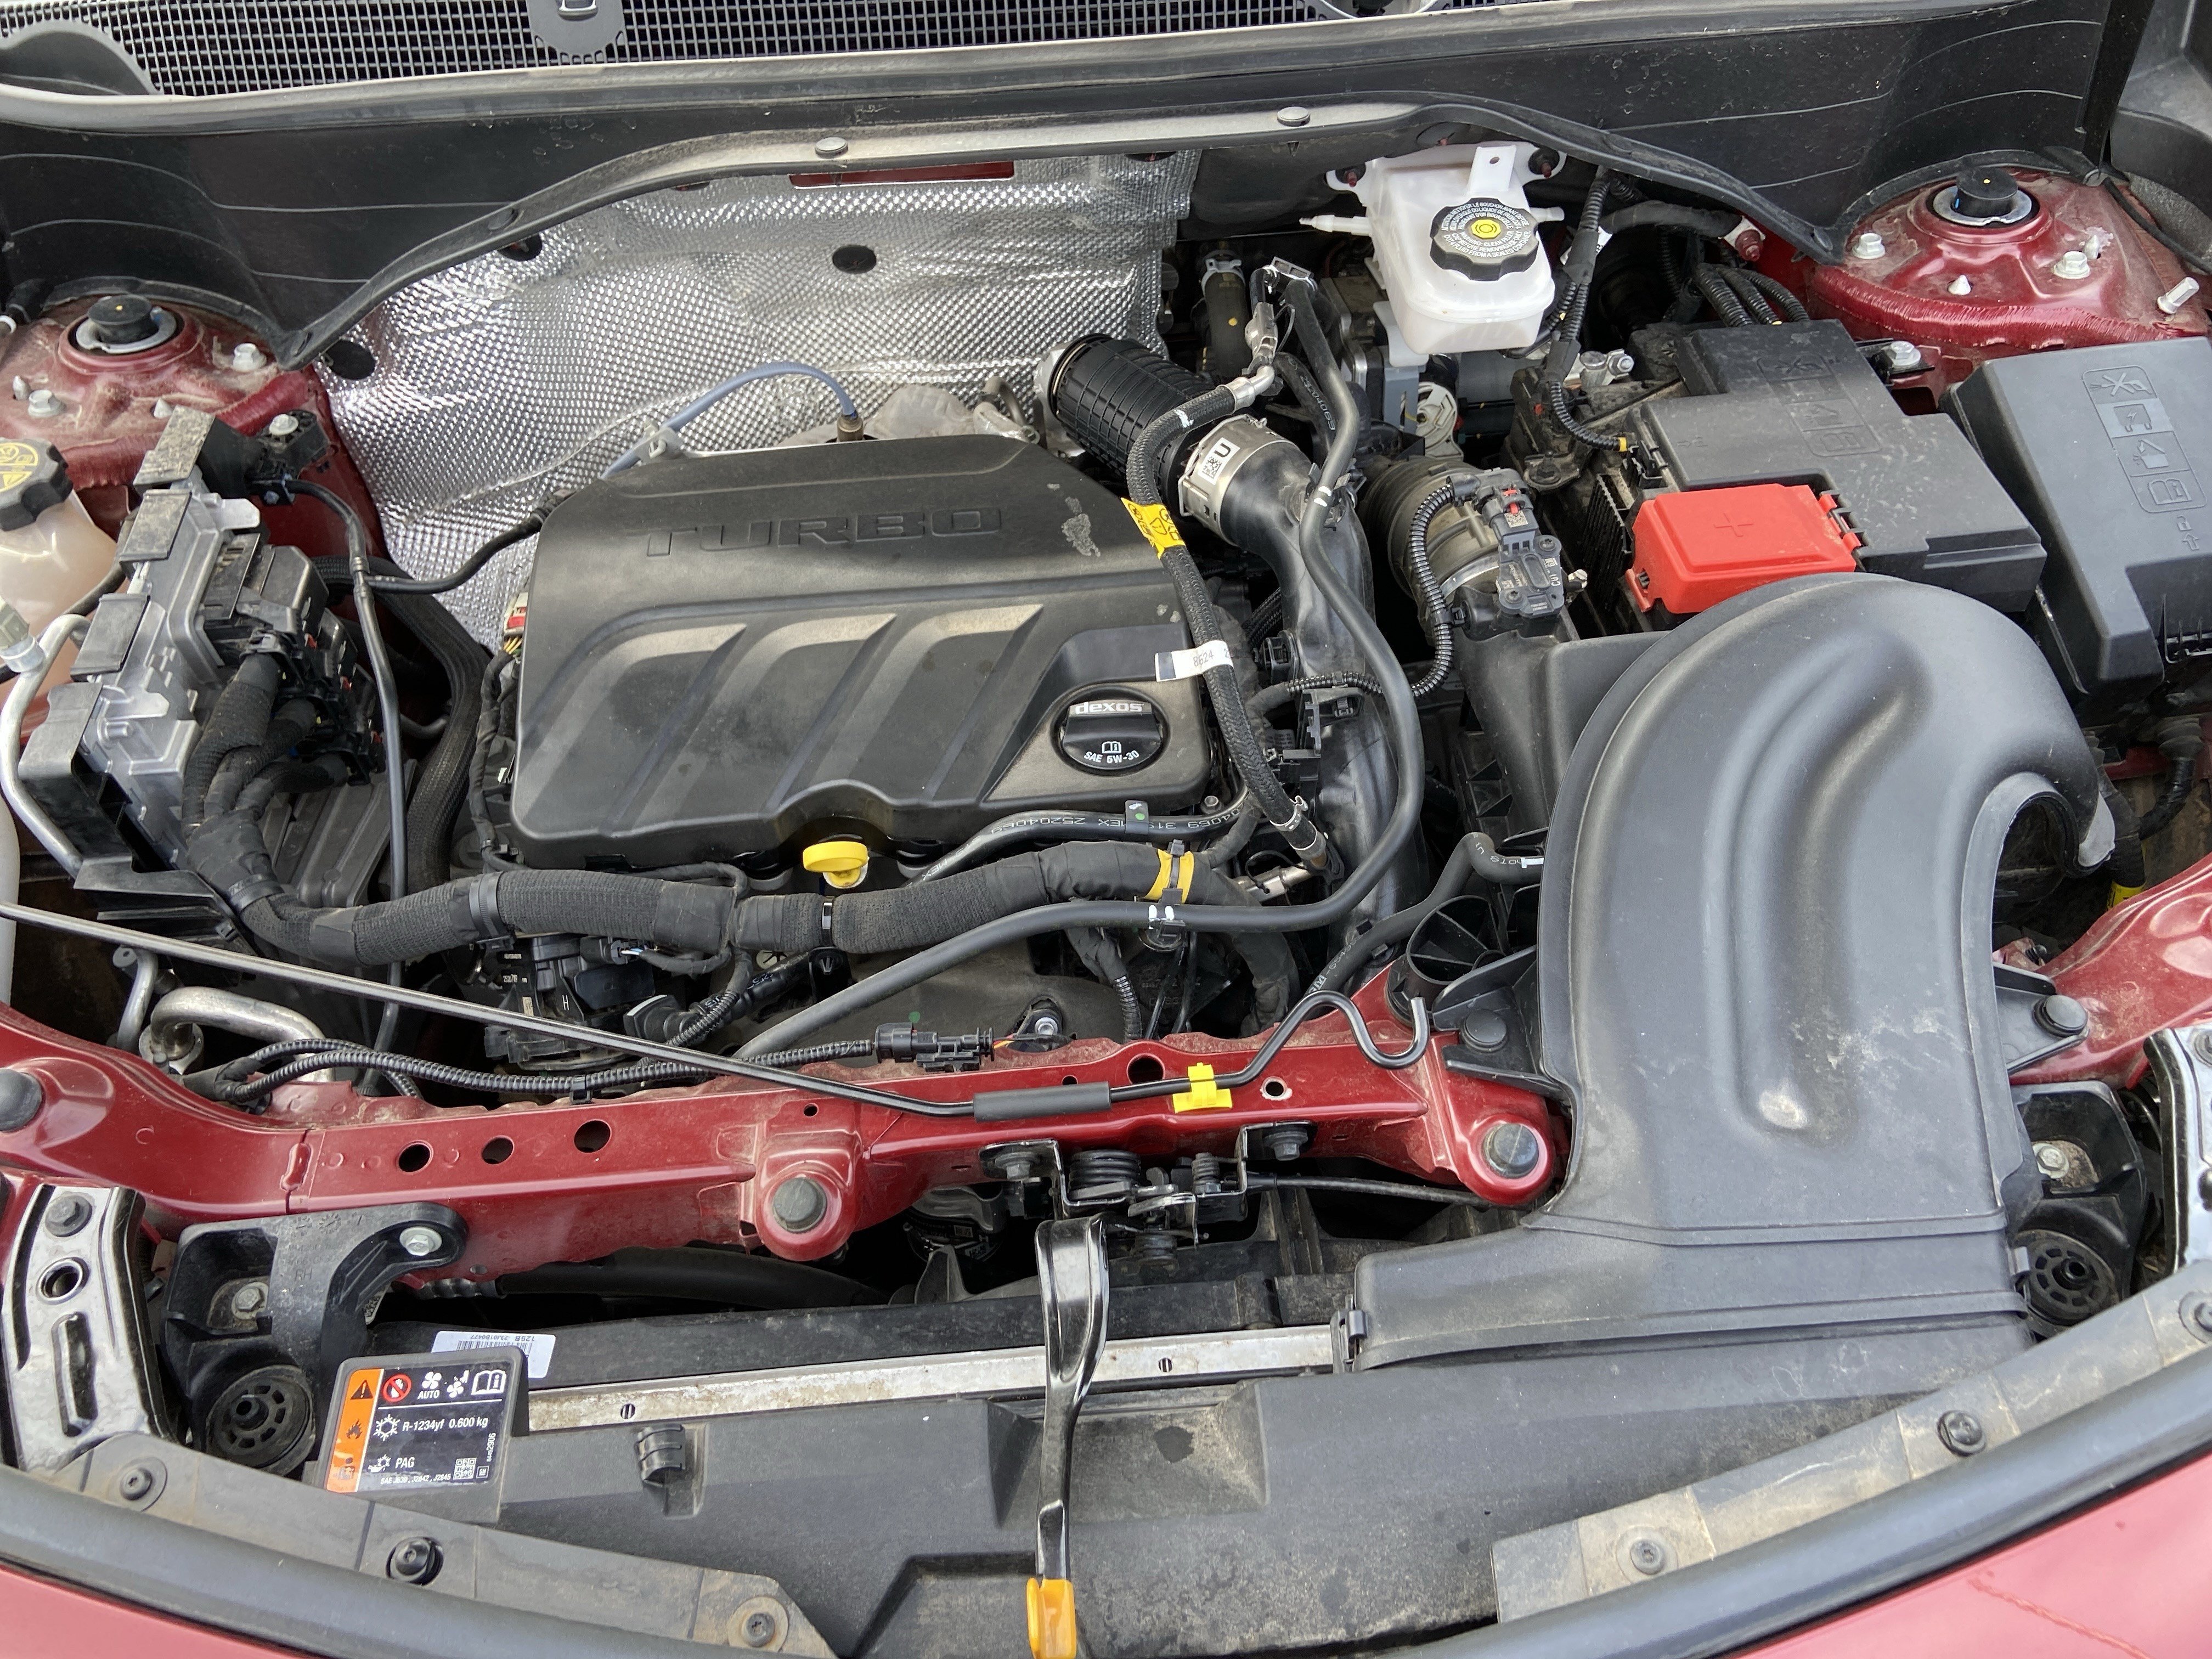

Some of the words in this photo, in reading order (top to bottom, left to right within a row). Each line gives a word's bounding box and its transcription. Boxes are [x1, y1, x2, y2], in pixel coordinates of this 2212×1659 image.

[629, 508, 1002, 557] TURBO
[1193, 650, 1214, 667] 8624
[1075, 702, 1143, 714] dexos
[1084, 751, 1102, 763] SAE
[1107, 749, 1140, 764] 5W-30
[991, 816, 1086, 834] 25204069
[417, 1390, 440, 1400] AUTO
[402, 1420, 444, 1432] R-1234yf
[449, 1418, 475, 1428] 0.600
[476, 1417, 488, 1427] kg
[395, 1457, 415, 1469] PAG
